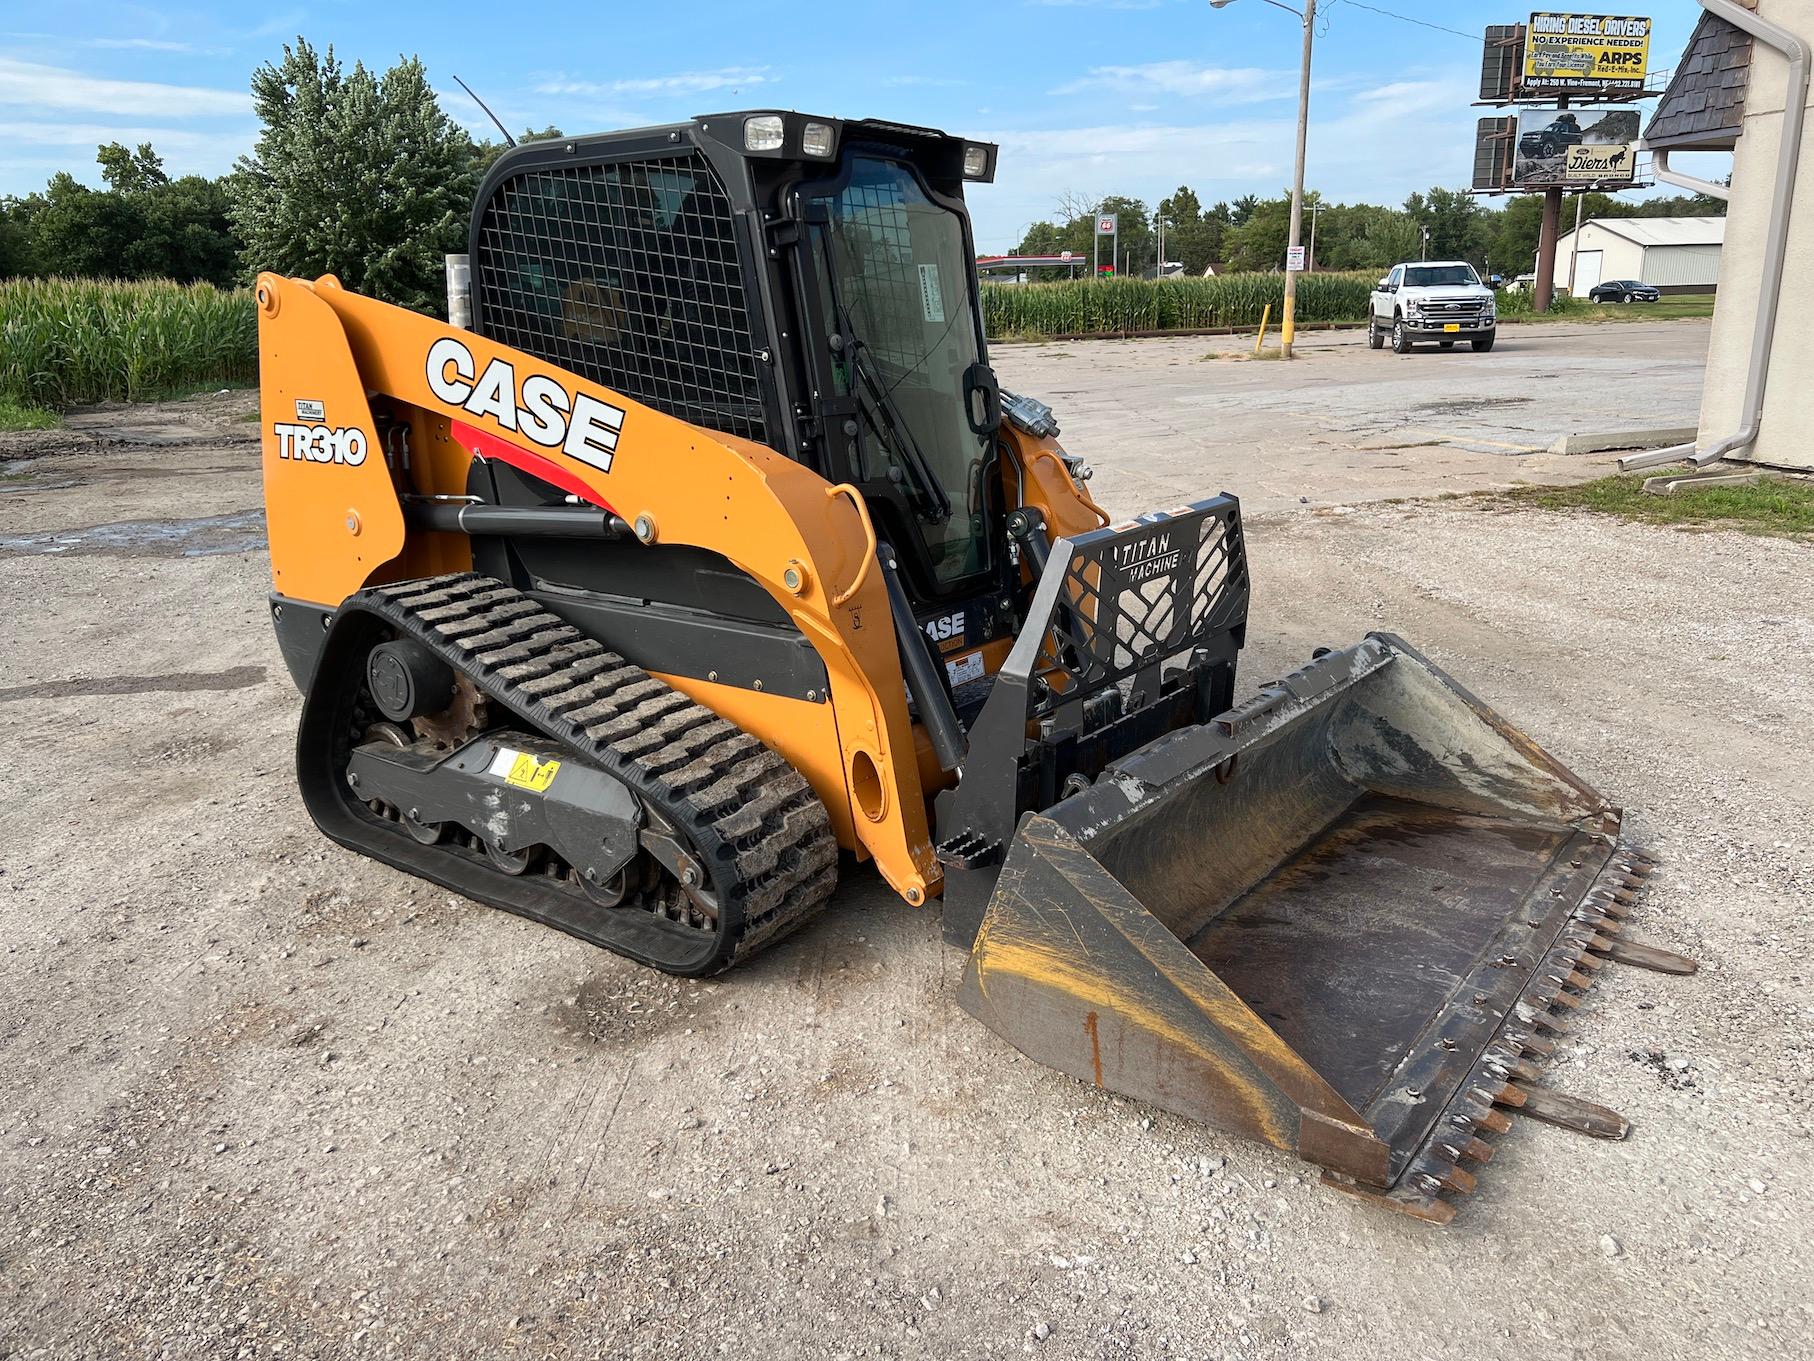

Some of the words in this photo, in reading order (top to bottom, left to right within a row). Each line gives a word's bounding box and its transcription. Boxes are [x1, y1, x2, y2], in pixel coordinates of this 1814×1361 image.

[1533, 16, 1566, 33] HIRING
[1567, 17, 1601, 35] DIESEL
[1603, 19, 1647, 37] DRIVERS
[1532, 36, 1546, 44] NO
[1549, 36, 1604, 46] EXPERIENCE
[1599, 51, 1642, 64] ARPS
[1526, 78, 1541, 87] Apply
[1568, 156, 1608, 170] Diers
[297, 402, 313, 410] TITAN
[425, 337, 626, 474] CASE
[274, 422, 368, 467] TR310
[1123, 532, 1171, 565] TITAN
[918, 611, 965, 641] ASE
